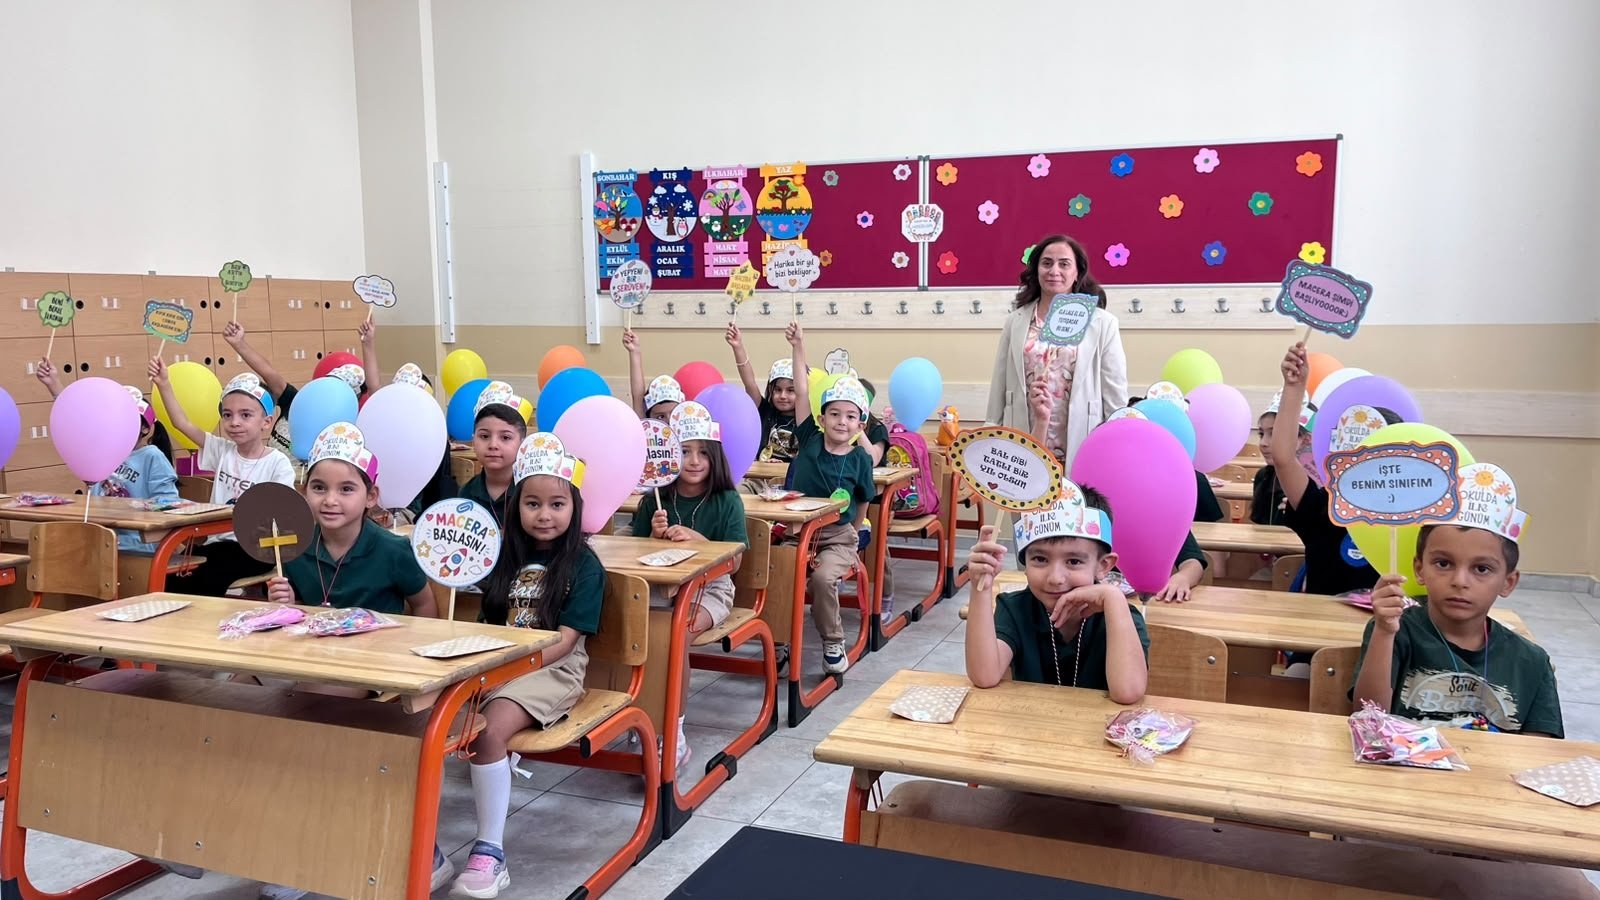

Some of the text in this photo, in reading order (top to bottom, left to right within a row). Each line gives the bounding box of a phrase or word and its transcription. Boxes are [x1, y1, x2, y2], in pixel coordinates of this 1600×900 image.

[775, 165, 793, 174] YAZ
[597, 173, 635, 182] SONBAHAR
[662, 172, 678, 181] KIŞ
[606, 244, 628, 253] EYLÜL
[656, 245, 685, 253] ARALIK
[606, 256, 625, 265] EKİM
[656, 257, 678, 265] OCAK
[713, 255, 737, 264] NİSAN
[774, 261, 795, 269] Harika
[806, 258, 814, 268] yıl
[657, 269, 681, 278] ŞUBAT
[775, 268, 812, 278] bizi bekliyor
[1298, 280, 1354, 308] MACERA ŞİMDİ
[1344, 426, 1370, 435] OKULDA
[322, 437, 348, 446] OKULDA
[990, 447, 1028, 467] BAL GİBİ
[983, 454, 1029, 479] TATLI BİR
[1378, 464, 1401, 477] İŞTE
[979, 464, 1027, 490] YIL OLSUN
[1351, 477, 1432, 490] BENİM SINIFIM
[1460, 490, 1497, 505] OKULDA
[436, 513, 488, 540] MACERA
[433, 527, 487, 555] BAŞLASIN!
